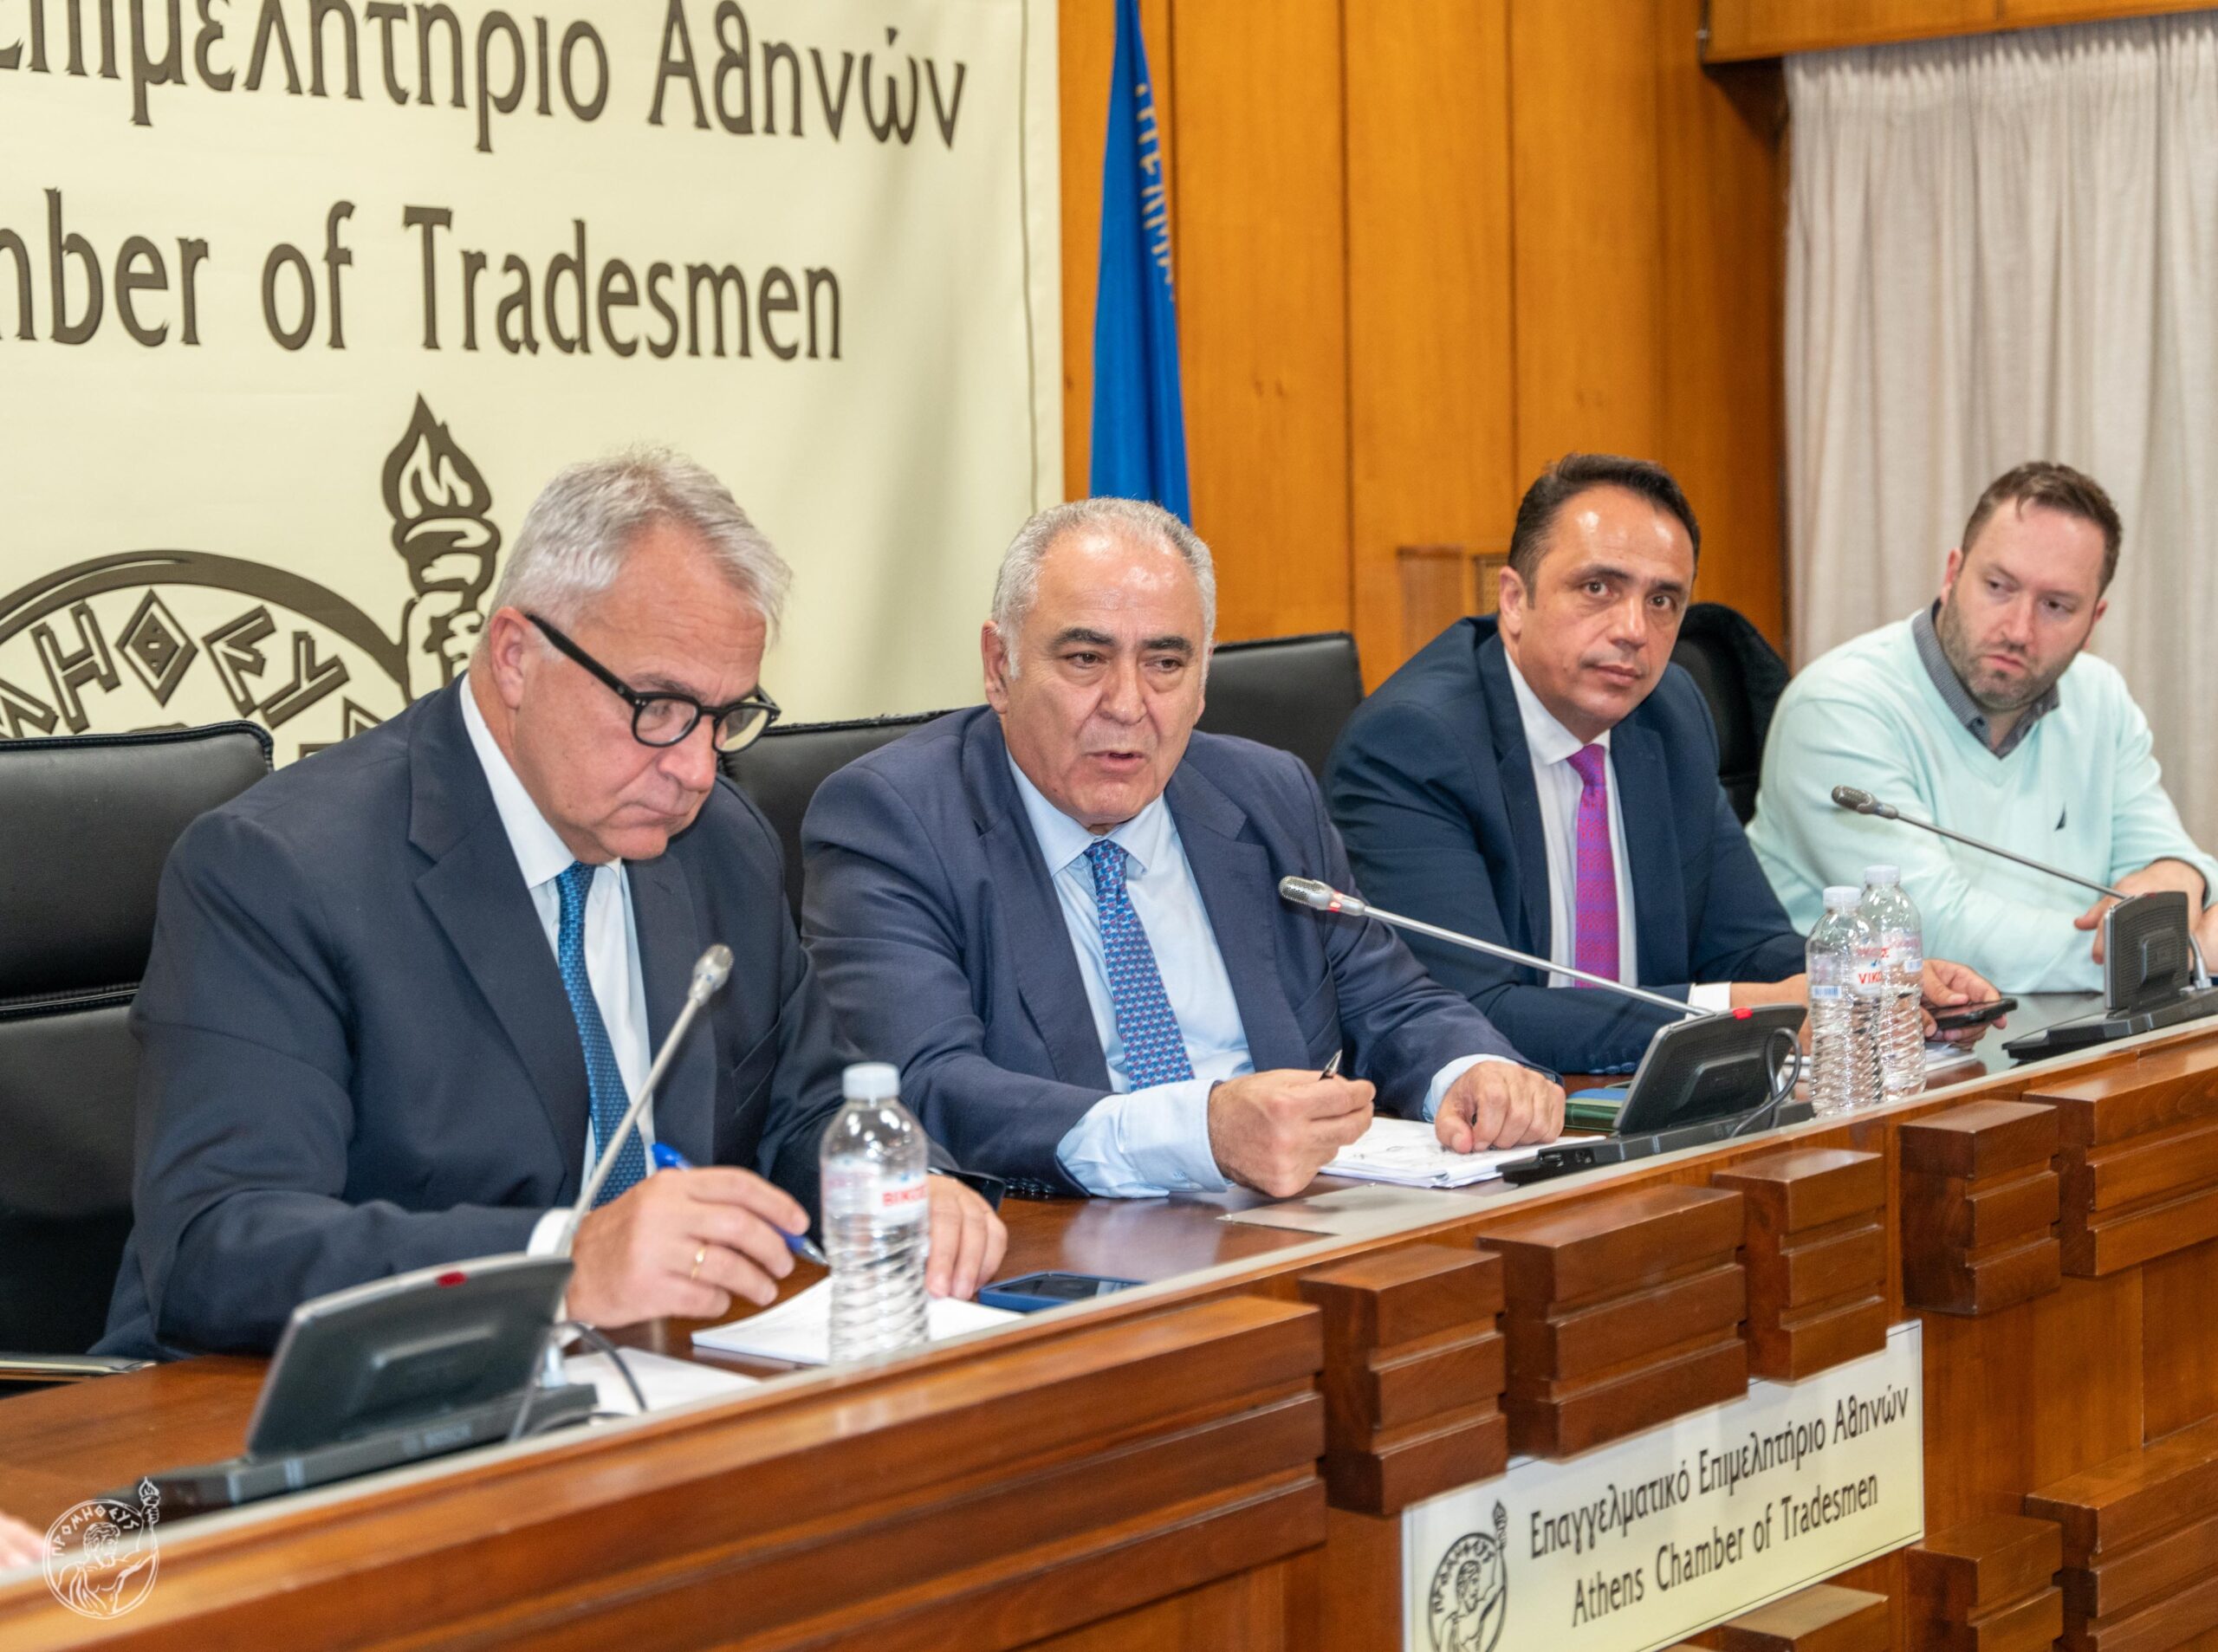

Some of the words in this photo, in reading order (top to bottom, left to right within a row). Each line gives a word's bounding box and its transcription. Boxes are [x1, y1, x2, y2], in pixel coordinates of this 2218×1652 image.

[263, 200, 355, 350] of
[402, 204, 842, 361] Tradesmen
[1530, 1459, 1690, 1560] Επαγγελματικό
[1699, 1418, 1826, 1496] Επιμελητήριο
[1832, 1384, 1909, 1444] Αθηνών
[1572, 1567, 1644, 1628] Athens
[1656, 1526, 1744, 1591] Chamber
[1753, 1502, 1773, 1552] of
[1780, 1474, 1879, 1541] Tradesmen
